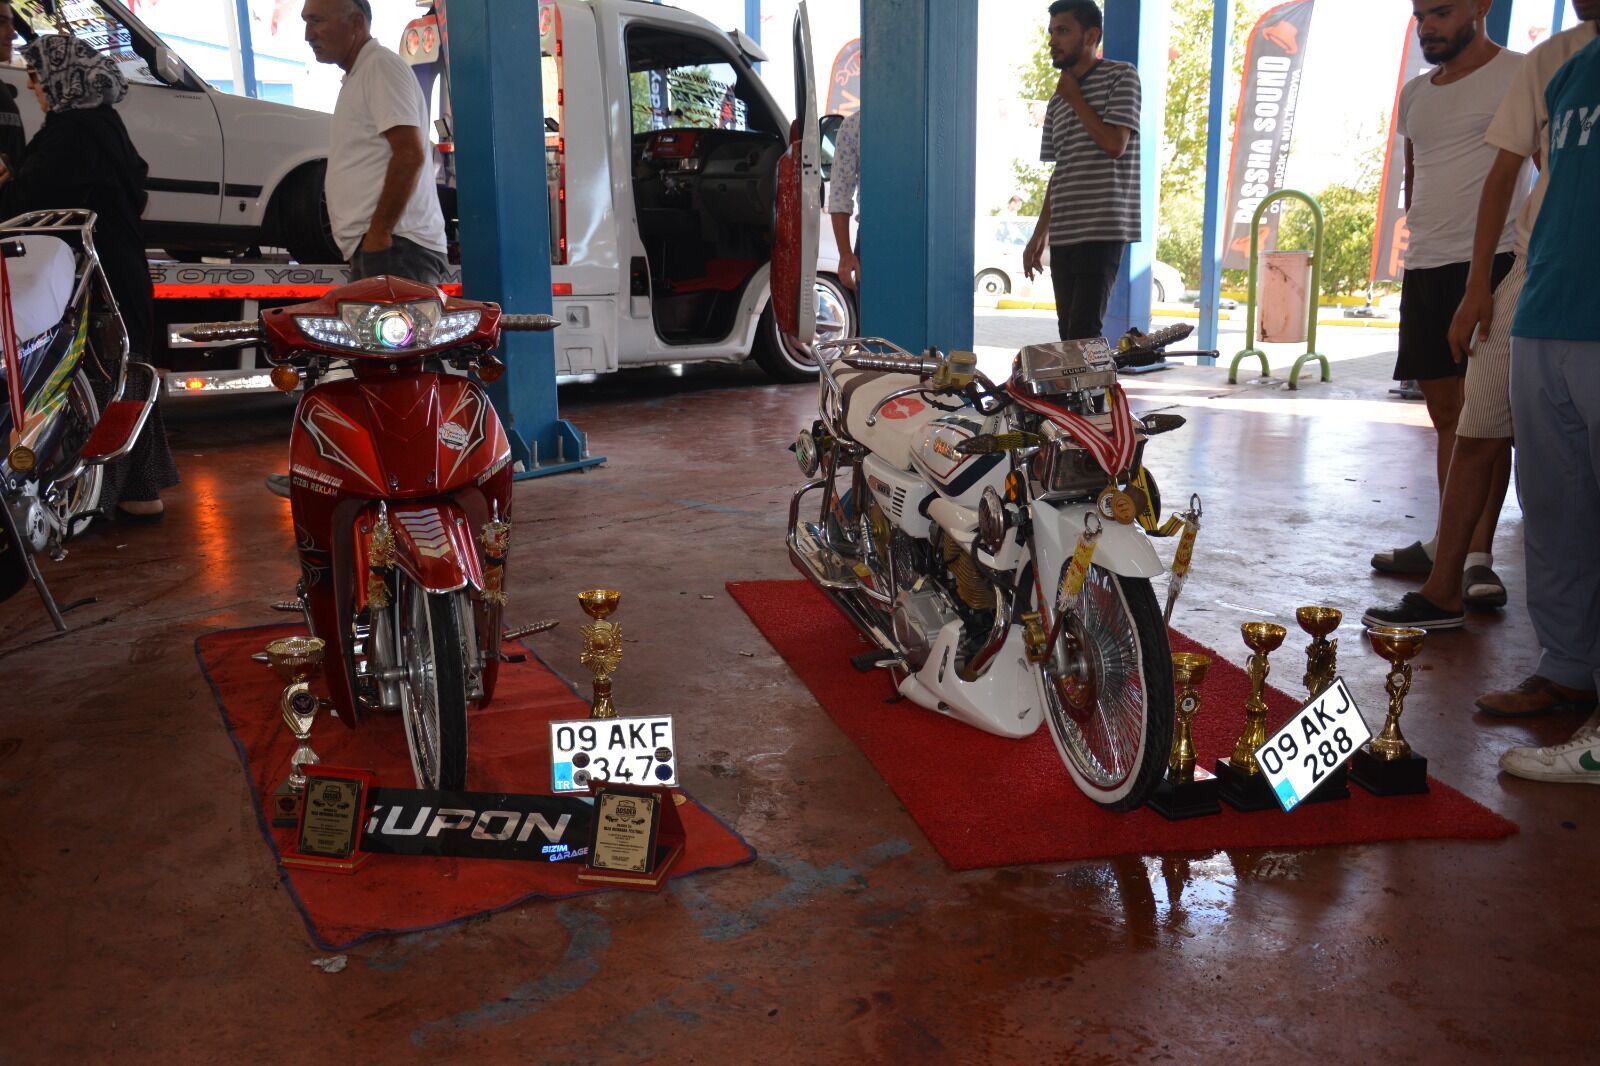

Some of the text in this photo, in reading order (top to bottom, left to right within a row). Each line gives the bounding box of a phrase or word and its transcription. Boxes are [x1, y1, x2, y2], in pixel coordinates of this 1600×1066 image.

[1235, 56, 1292, 224] PASSHA SOUND
[1280, 144, 1288, 152] &
[176, 268, 255, 284] OTO
[264, 268, 334, 285] YOL
[557, 722, 668, 752] 09 AKF
[1262, 684, 1349, 774] 09 AKJ
[1303, 727, 1353, 783] 288
[593, 755, 653, 783] 347
[557, 780, 570, 789] TR
[1284, 796, 1298, 810] TR
[549, 847, 589, 862] GARAGE
